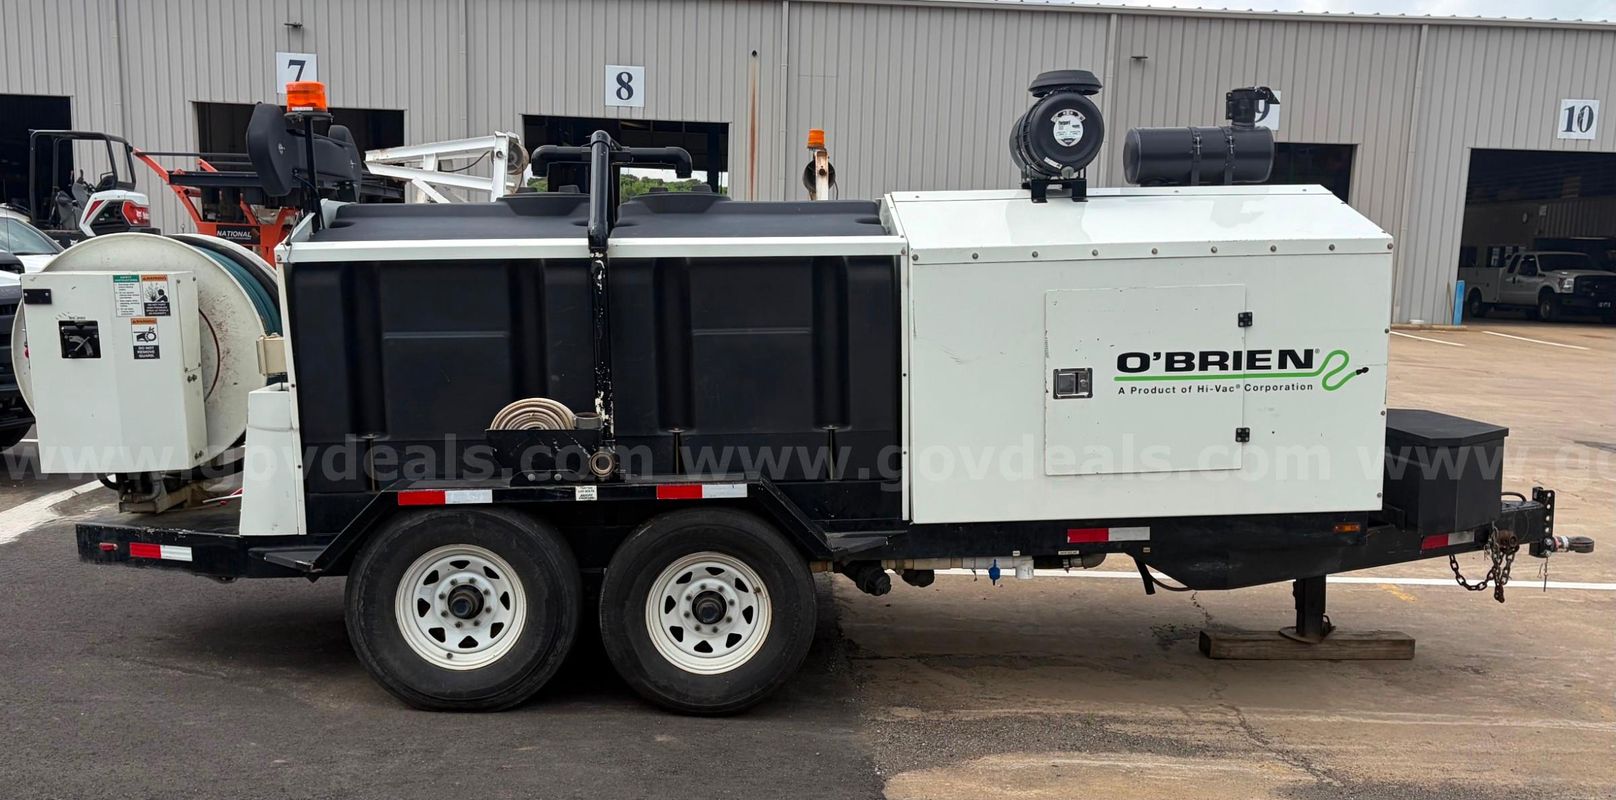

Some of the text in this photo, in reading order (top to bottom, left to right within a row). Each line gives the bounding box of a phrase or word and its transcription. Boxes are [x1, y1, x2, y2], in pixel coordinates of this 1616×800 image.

[287, 59, 307, 82] 7
[616, 71, 634, 101] 8
[1561, 104, 1594, 133] 10
[216, 230, 252, 238] NATIONAL
[1118, 387, 1125, 395] A
[1130, 386, 1176, 395] Product
[1181, 385, 1192, 394] of
[1244, 383, 1313, 393] Corporation
